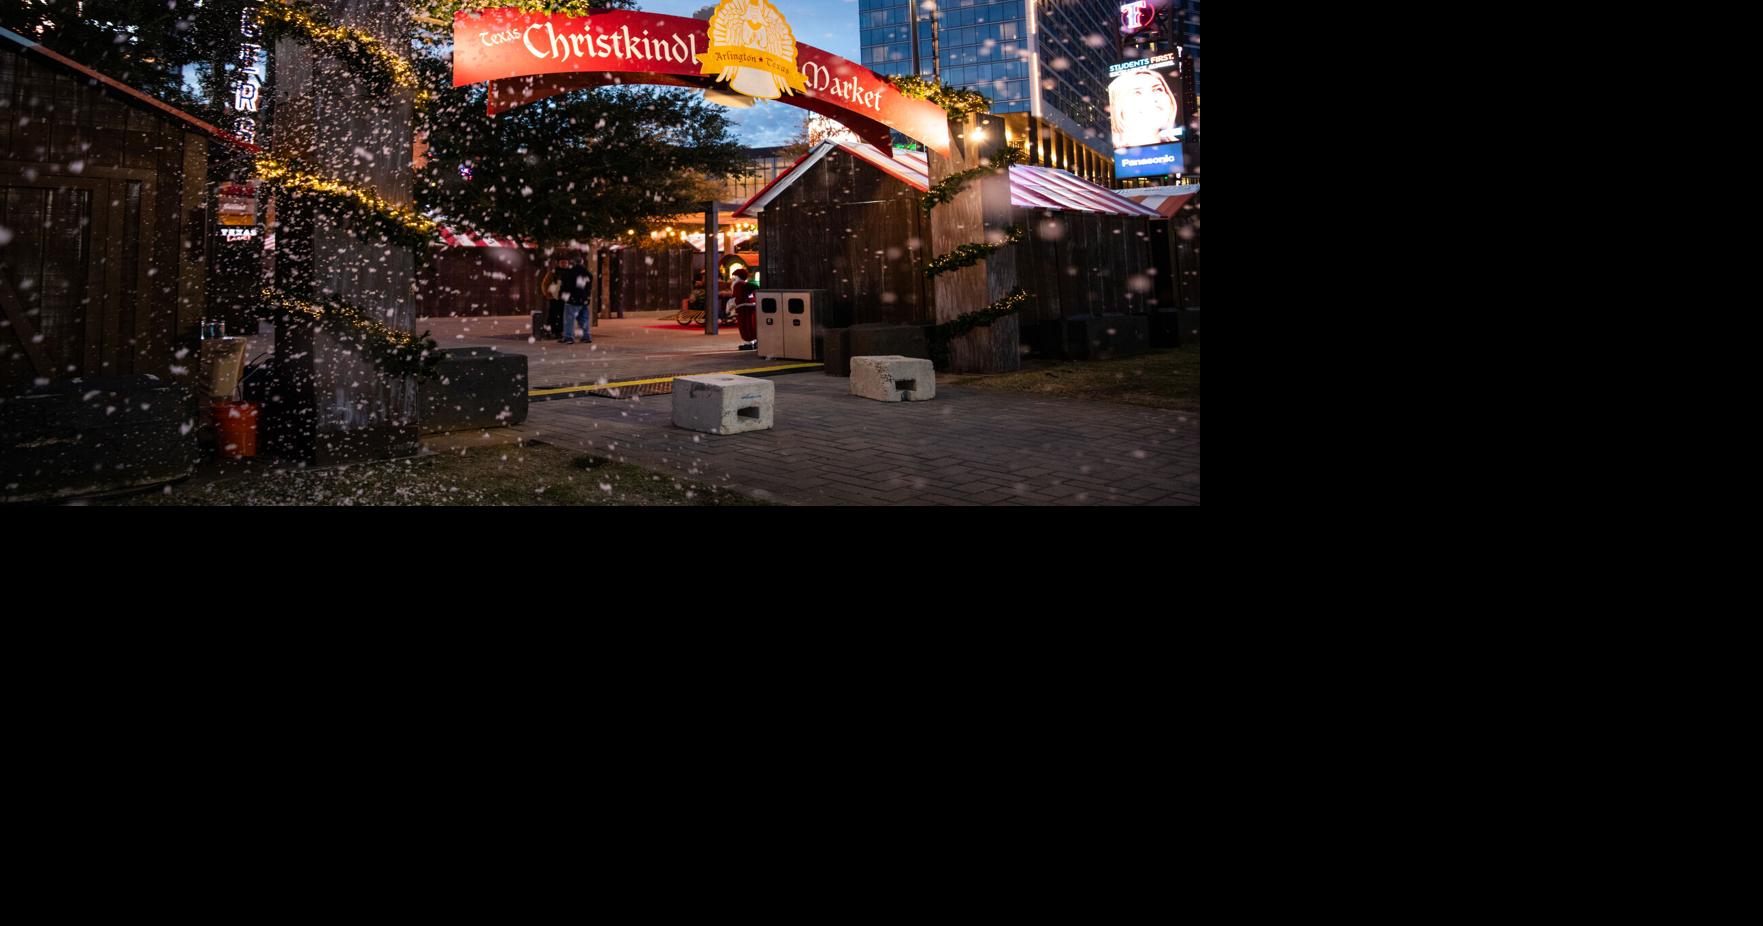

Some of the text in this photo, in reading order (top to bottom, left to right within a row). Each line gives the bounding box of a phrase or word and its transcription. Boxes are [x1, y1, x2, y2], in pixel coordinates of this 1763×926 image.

[479, 22, 882, 111] Texas Christkindl Market
[715, 51, 789, 74] Arlington Texas
[1109, 58, 1149, 72] STUDENTS
[1150, 53, 1175, 64] FIRST.
[1121, 154, 1175, 168] Panasonic
[220, 228, 257, 237] TEXAS
